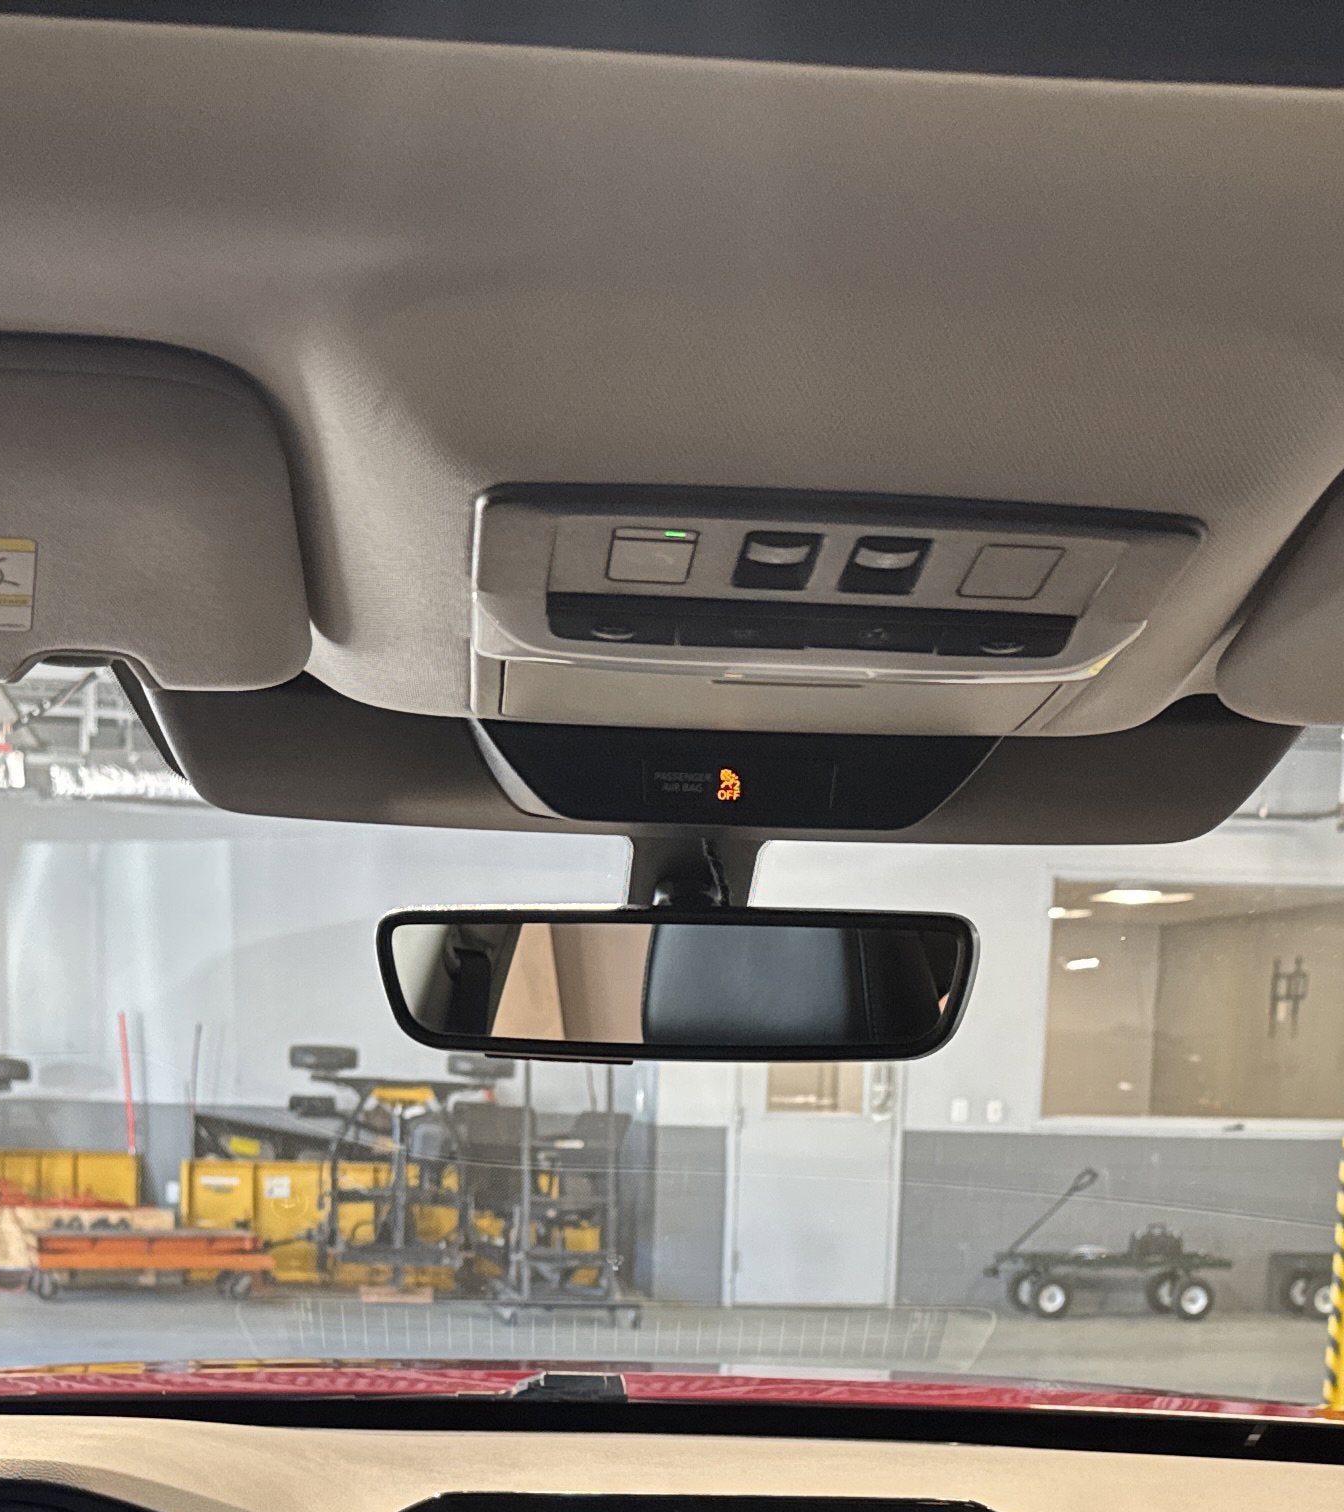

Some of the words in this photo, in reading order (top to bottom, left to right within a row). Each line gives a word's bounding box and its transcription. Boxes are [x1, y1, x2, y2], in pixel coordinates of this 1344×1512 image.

[663, 783, 680, 792] AIR
[682, 783, 703, 792] BAG
[716, 790, 741, 801] OFF
